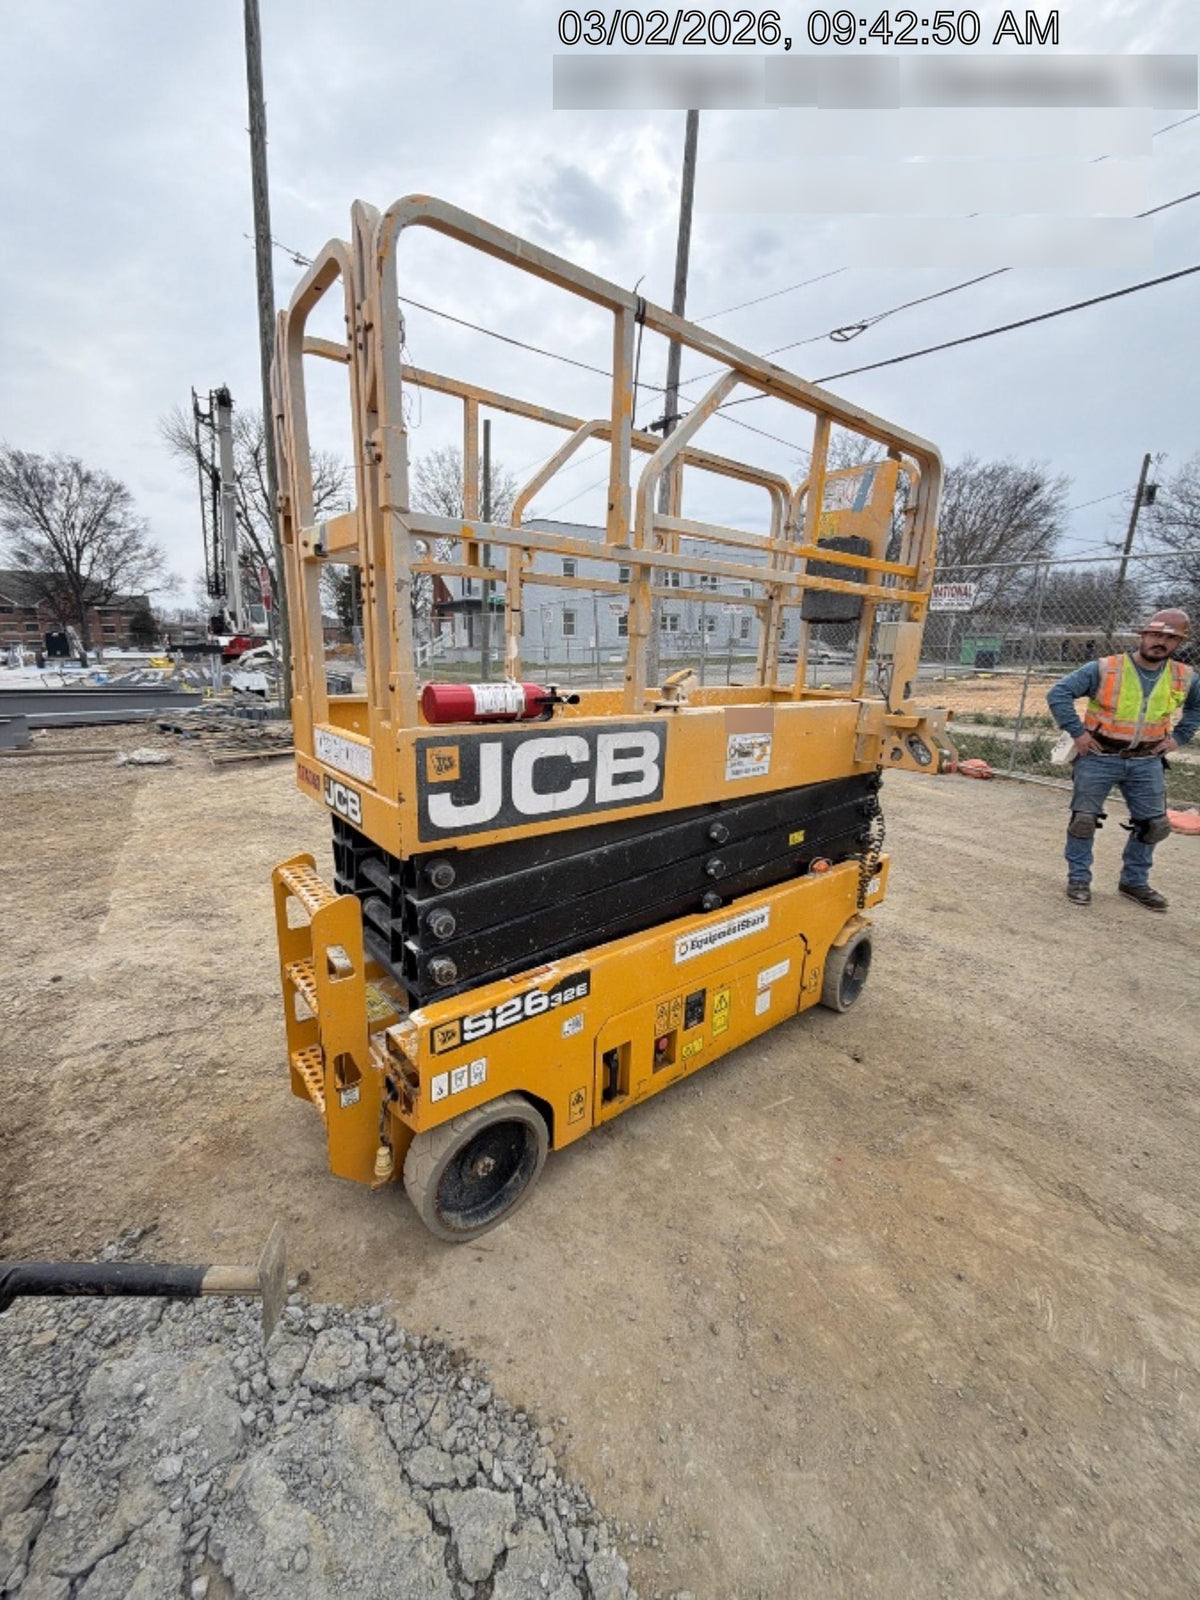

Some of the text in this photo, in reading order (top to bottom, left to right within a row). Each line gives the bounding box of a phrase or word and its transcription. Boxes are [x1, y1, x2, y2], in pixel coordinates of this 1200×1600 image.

[427, 730, 661, 829] JCB
[325, 780, 361, 824] JCB
[690, 913, 766, 951] EquipmentShare
